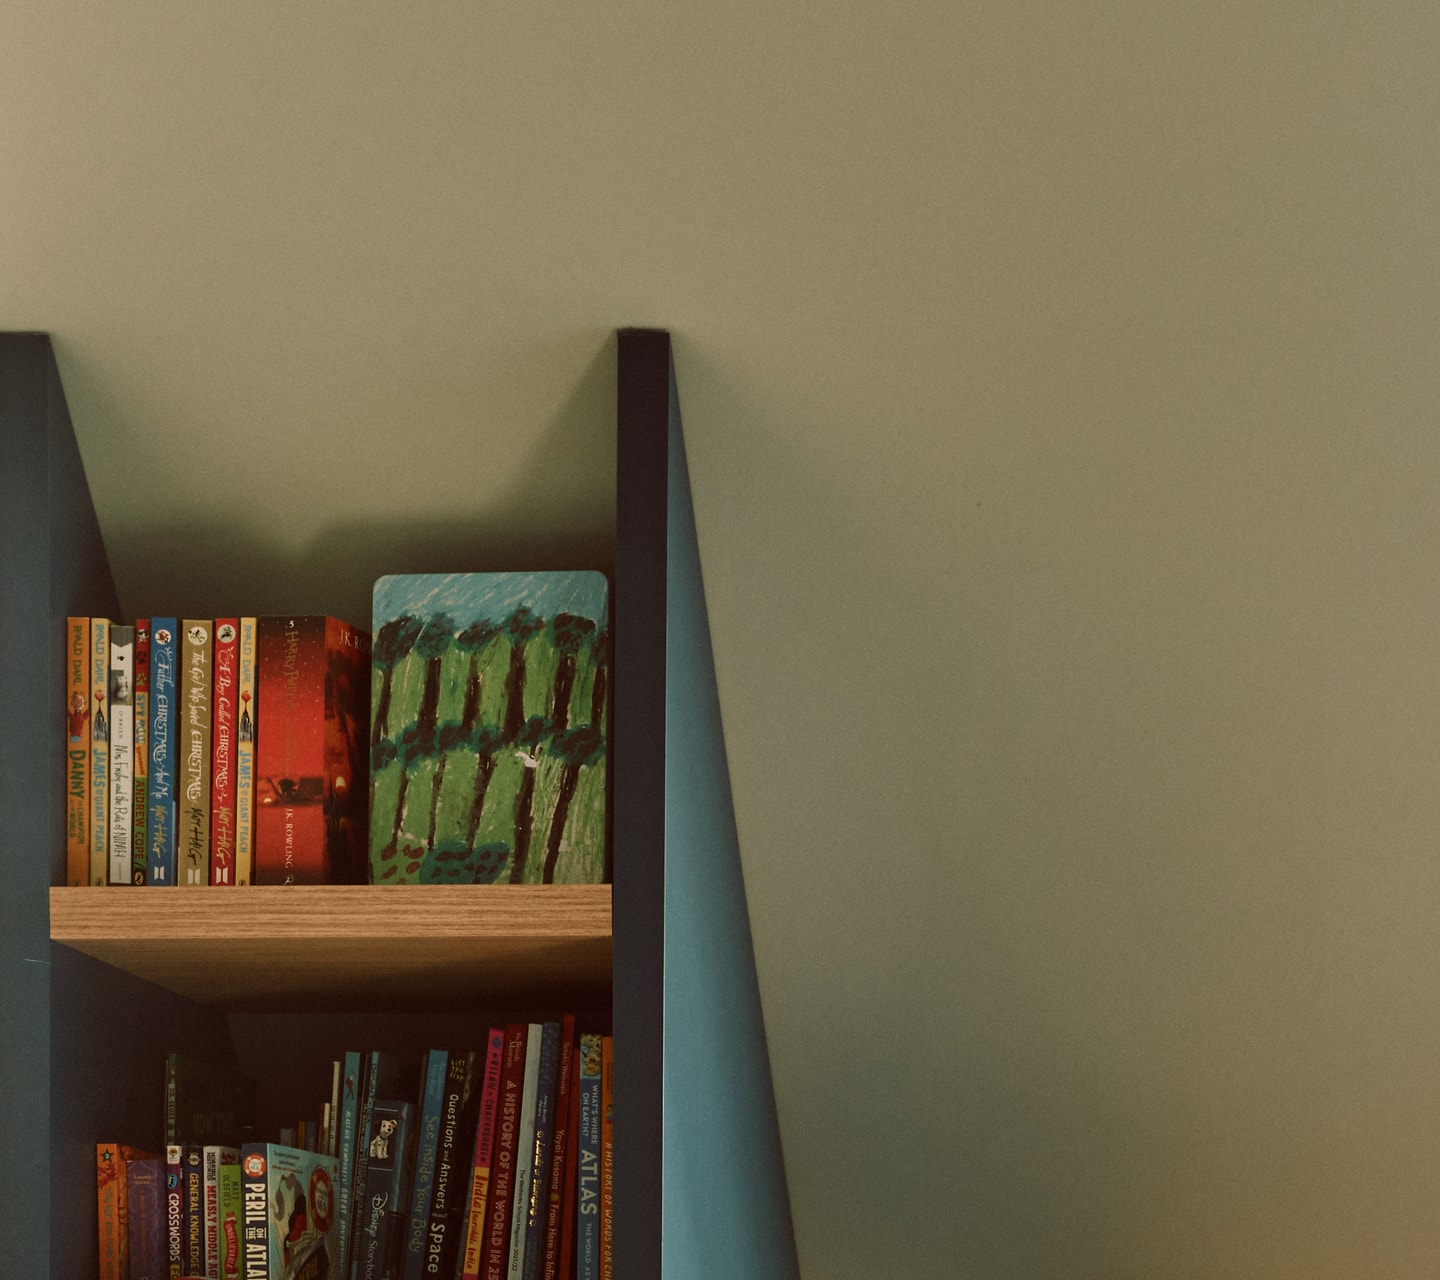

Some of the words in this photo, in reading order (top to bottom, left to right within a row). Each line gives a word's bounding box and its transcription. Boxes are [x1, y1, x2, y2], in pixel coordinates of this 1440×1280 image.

[95, 624, 105, 655] ROALD
[289, 620, 295, 629] 5
[73, 625, 83, 656] ROALD
[243, 625, 252, 656] ROALD
[73, 660, 83, 685] DAHL
[95, 659, 105, 685] DAHL
[242, 660, 252, 684] DAHL
[70, 750, 86, 799] DANNY
[93, 749, 107, 788] JAMES
[135, 781, 145, 827] ANDREW
[285, 808, 294, 822] J.K.
[135, 832, 145, 859] COPE
[285, 824, 294, 869] ROWLING
[506, 1080, 517, 1090] A
[582, 1092, 589, 1105] ON
[501, 1093, 517, 1150] HISTORY
[581, 1107, 589, 1136] EARTH?
[554, 1129, 565, 1153] Yayoi
[500, 1151, 511, 1169] OF
[552, 1155, 562, 1190] Kusama
[189, 1172, 200, 1213] GENERAL
[496, 1172, 509, 1196] THE
[580, 1149, 598, 1215] ATLAS
[207, 1185, 217, 1223] MEASLY
[549, 1204, 559, 1226] From
[168, 1192, 180, 1261] CROSSWORDS
[491, 1200, 506, 1247] WORLD
[546, 1229, 557, 1249] Here
[189, 1215, 200, 1268] KNOWLEDGE
[207, 1225, 218, 1260] MIDDLE
[427, 1222, 446, 1273] Space
[489, 1249, 502, 1264] IN
[546, 1251, 554, 1259] to
